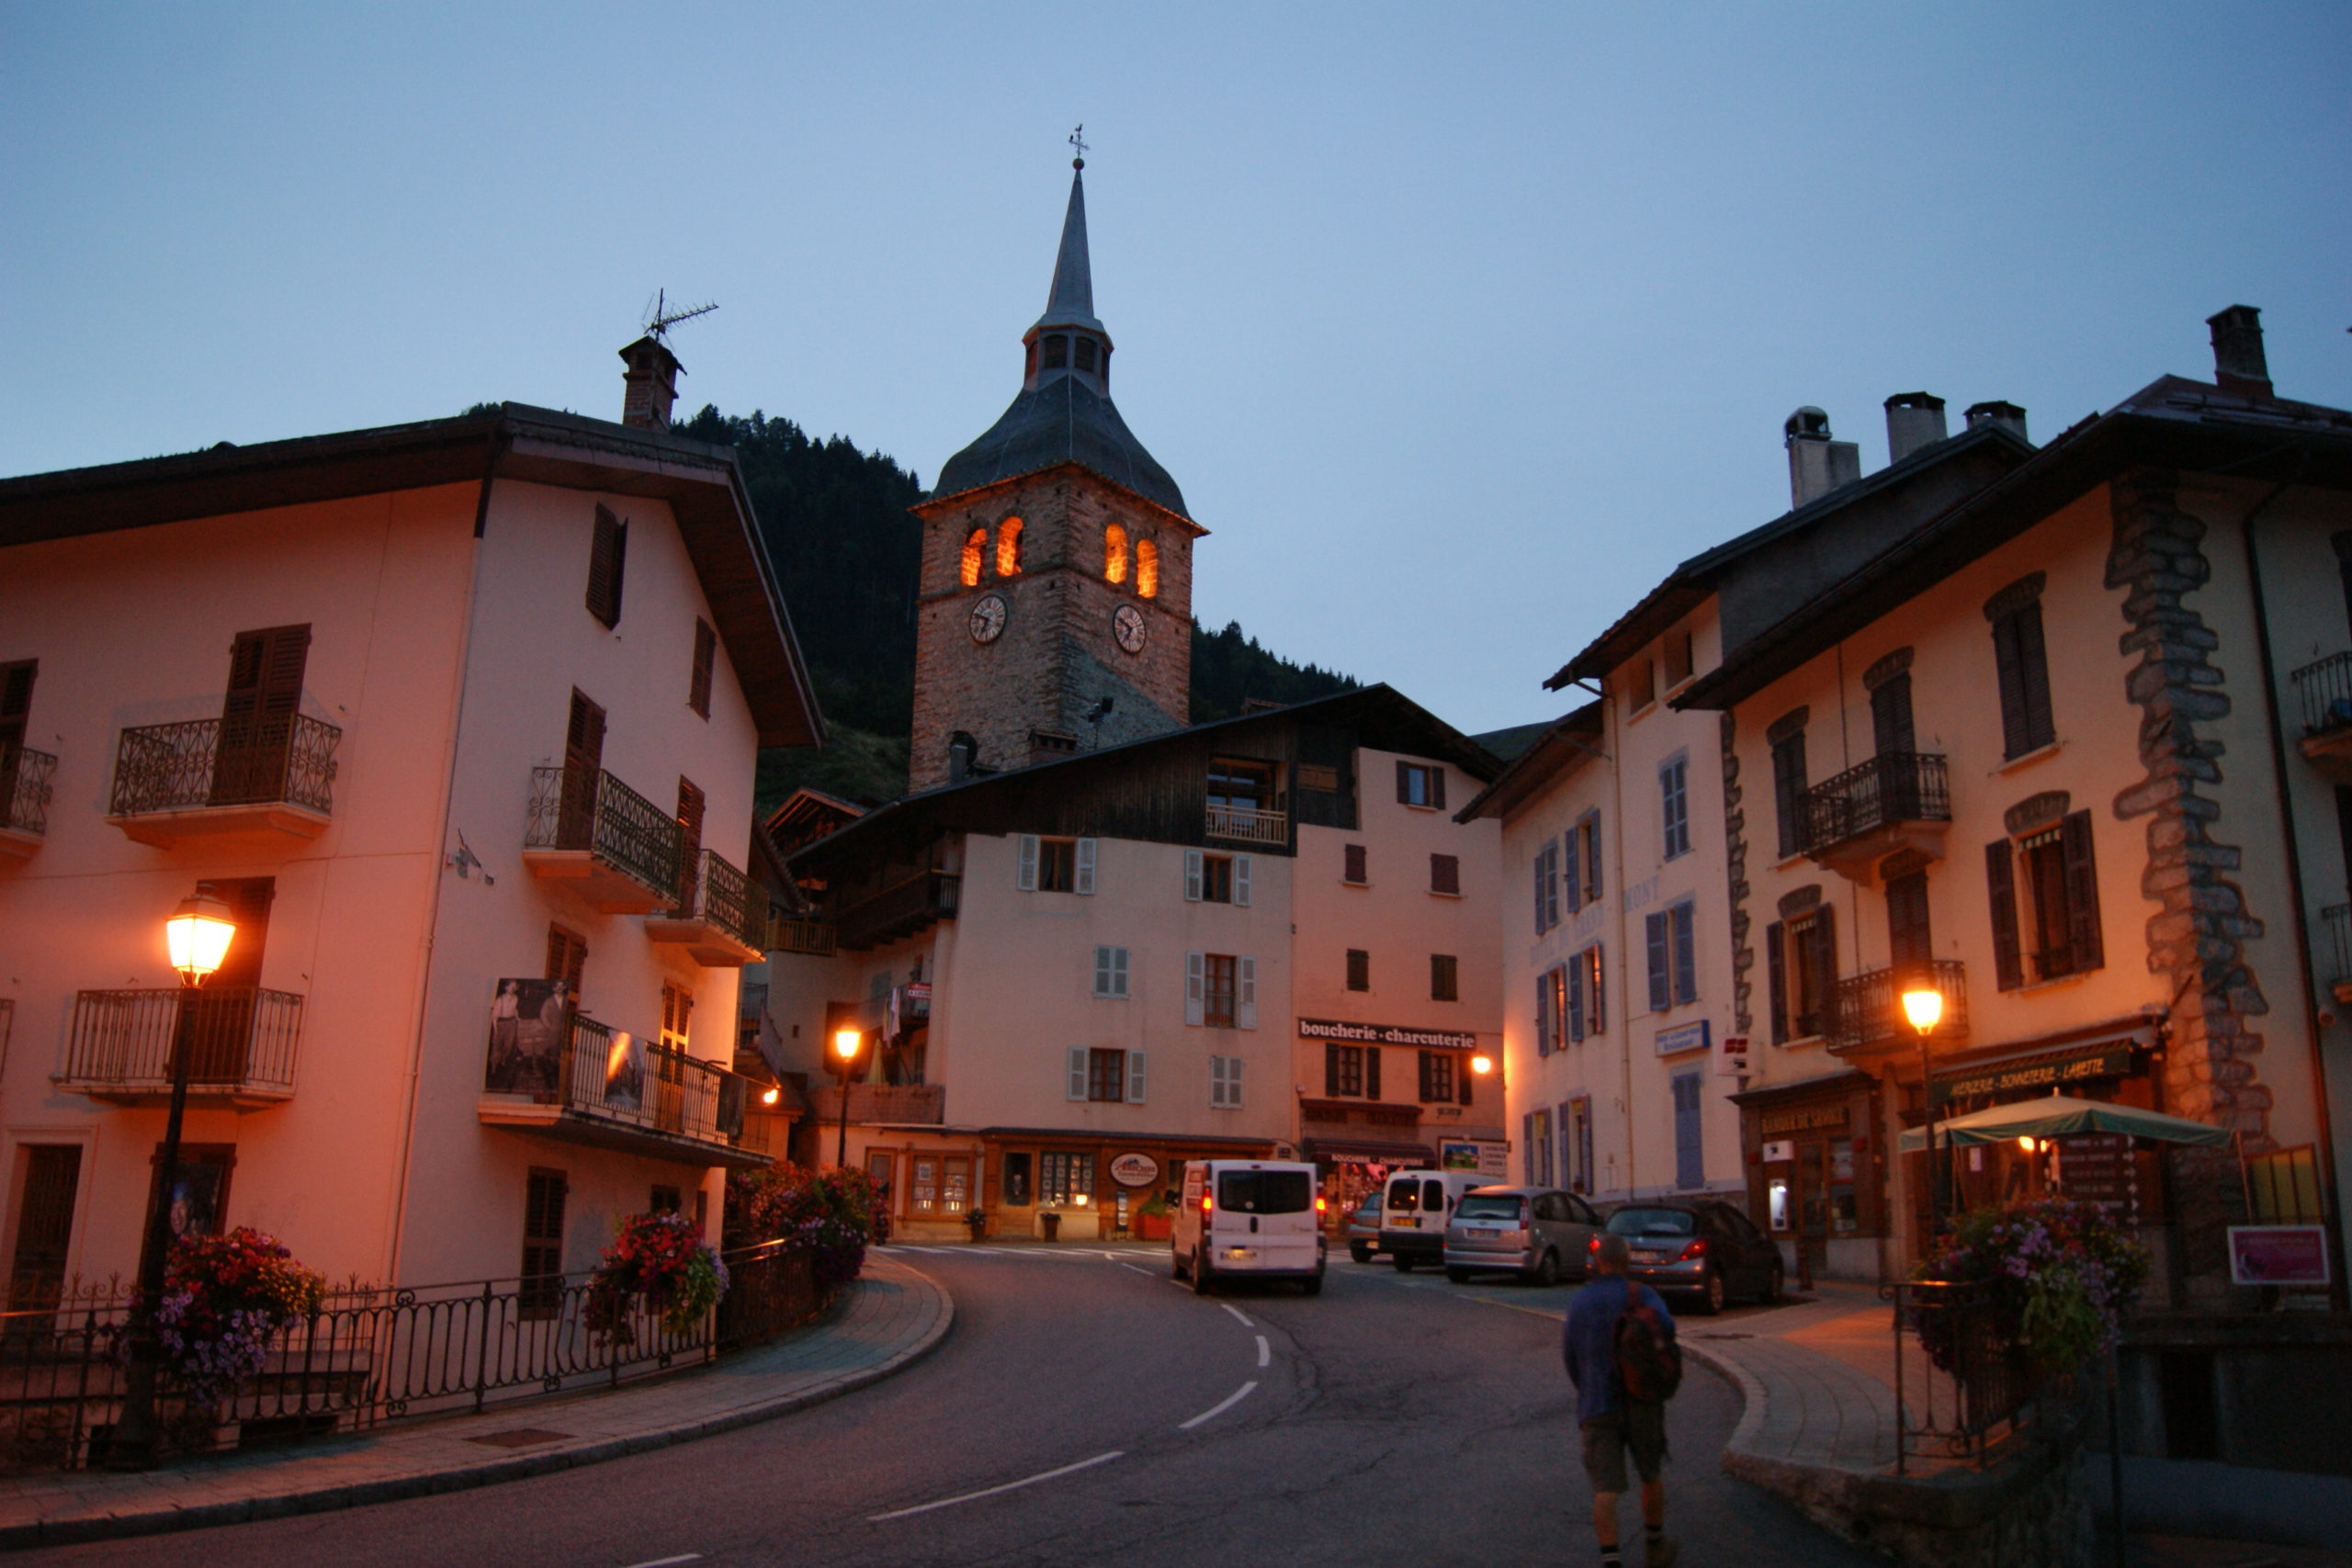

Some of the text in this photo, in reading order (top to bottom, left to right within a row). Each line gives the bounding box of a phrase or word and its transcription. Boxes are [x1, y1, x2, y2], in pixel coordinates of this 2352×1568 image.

[1300, 1021, 1476, 1048] boucherie charcuterie
[1951, 1057, 2105, 1097] MERCERIE BONNETERIE LAYETTE
[1331, 1154, 1424, 1167] BOUCHERIE CHARCUTERIE
